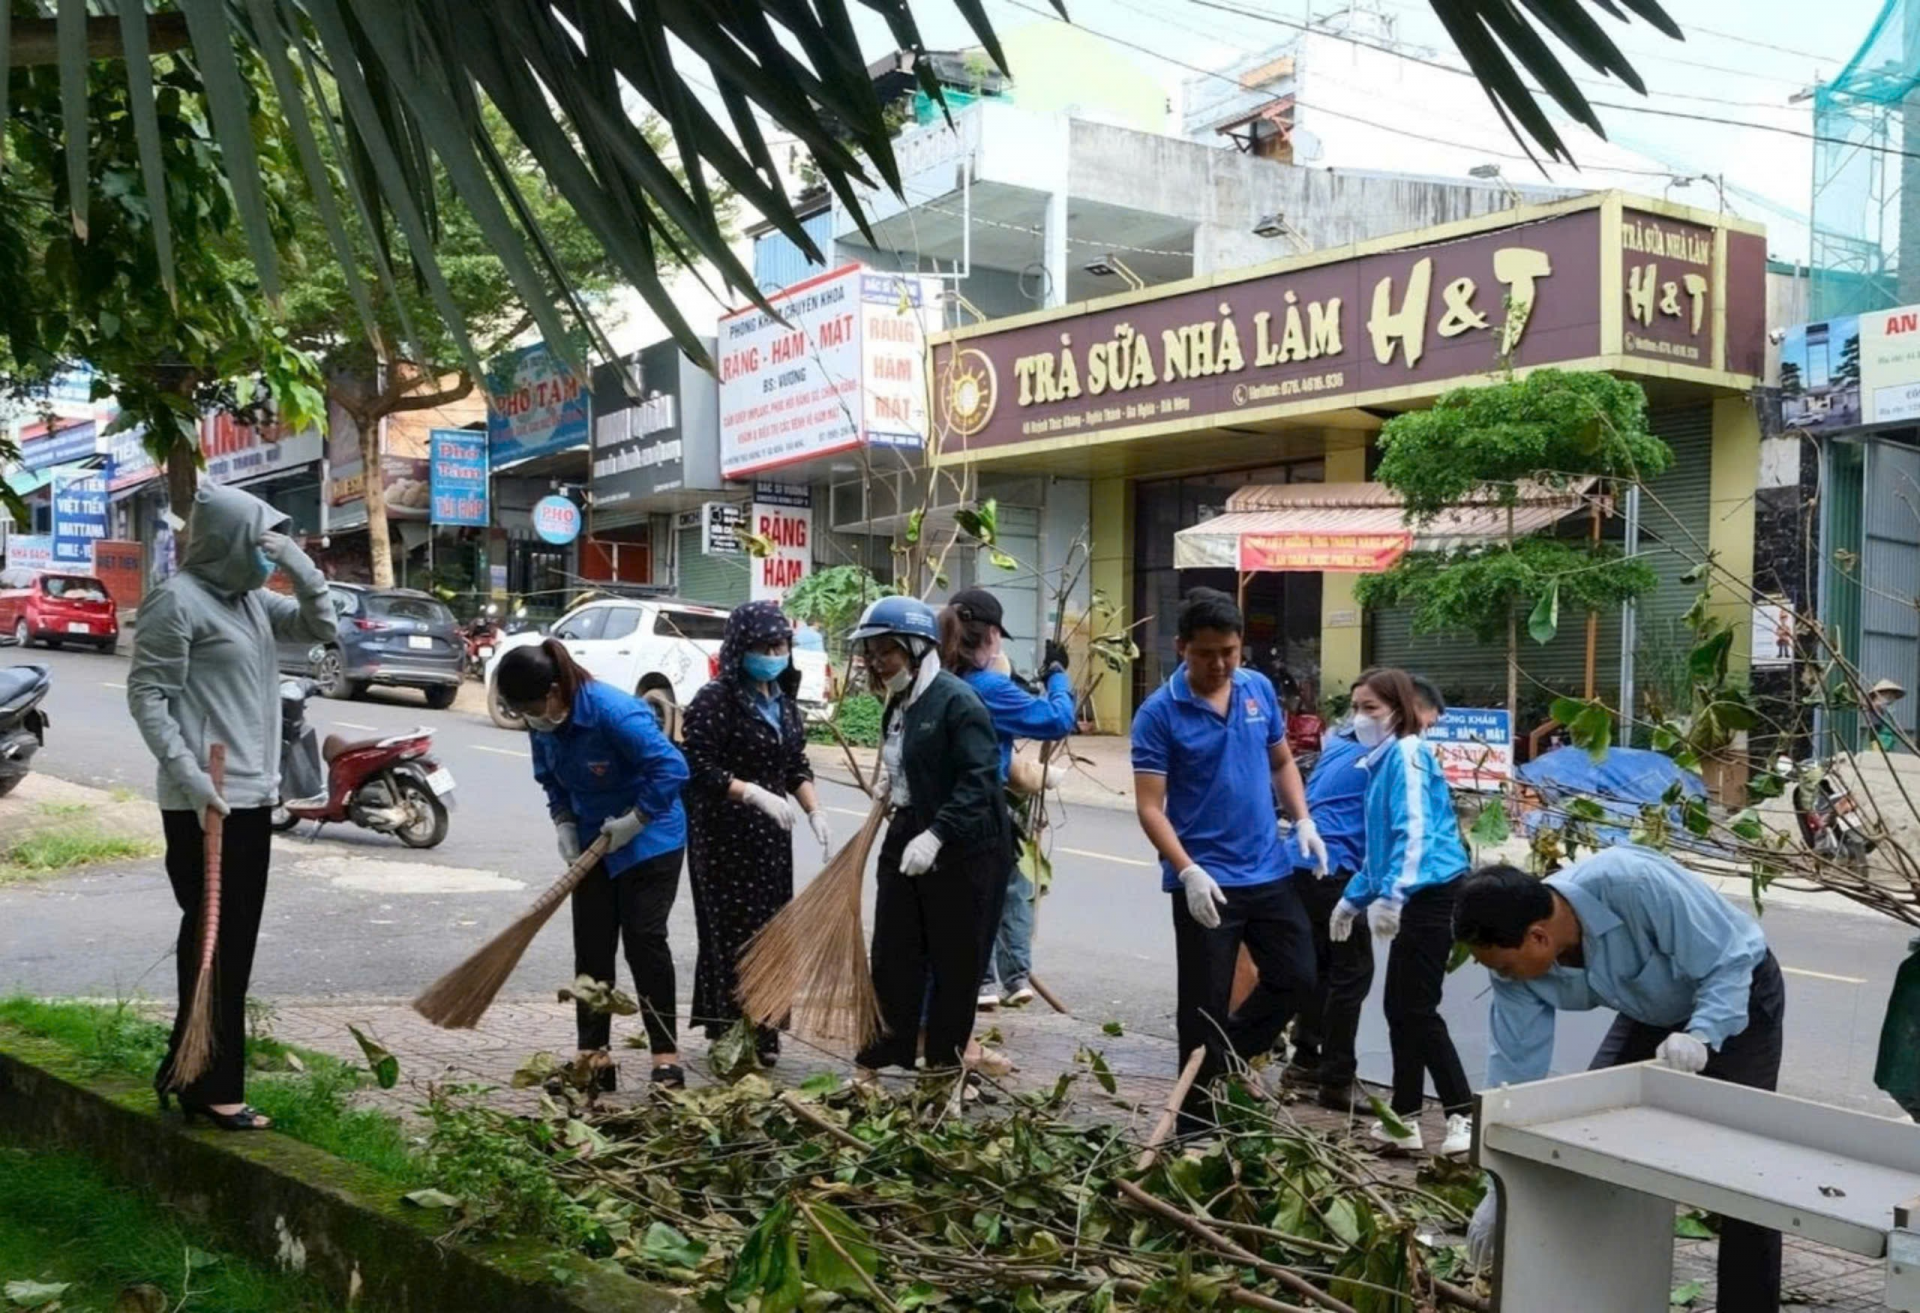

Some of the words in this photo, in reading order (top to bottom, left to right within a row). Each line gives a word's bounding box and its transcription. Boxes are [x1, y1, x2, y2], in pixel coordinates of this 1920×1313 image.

[723, 346, 759, 381] RĂNG
[771, 329, 805, 365] HÀM
[819, 314, 854, 354] MẶT
[1014, 332, 1083, 408] TRÀ
[1087, 322, 1157, 395] SỮA
[1161, 302, 1245, 381] NHÀ
[1253, 289, 1343, 368] LÀM
[760, 510, 807, 548] RĂNG
[764, 552, 802, 587] HÀM
